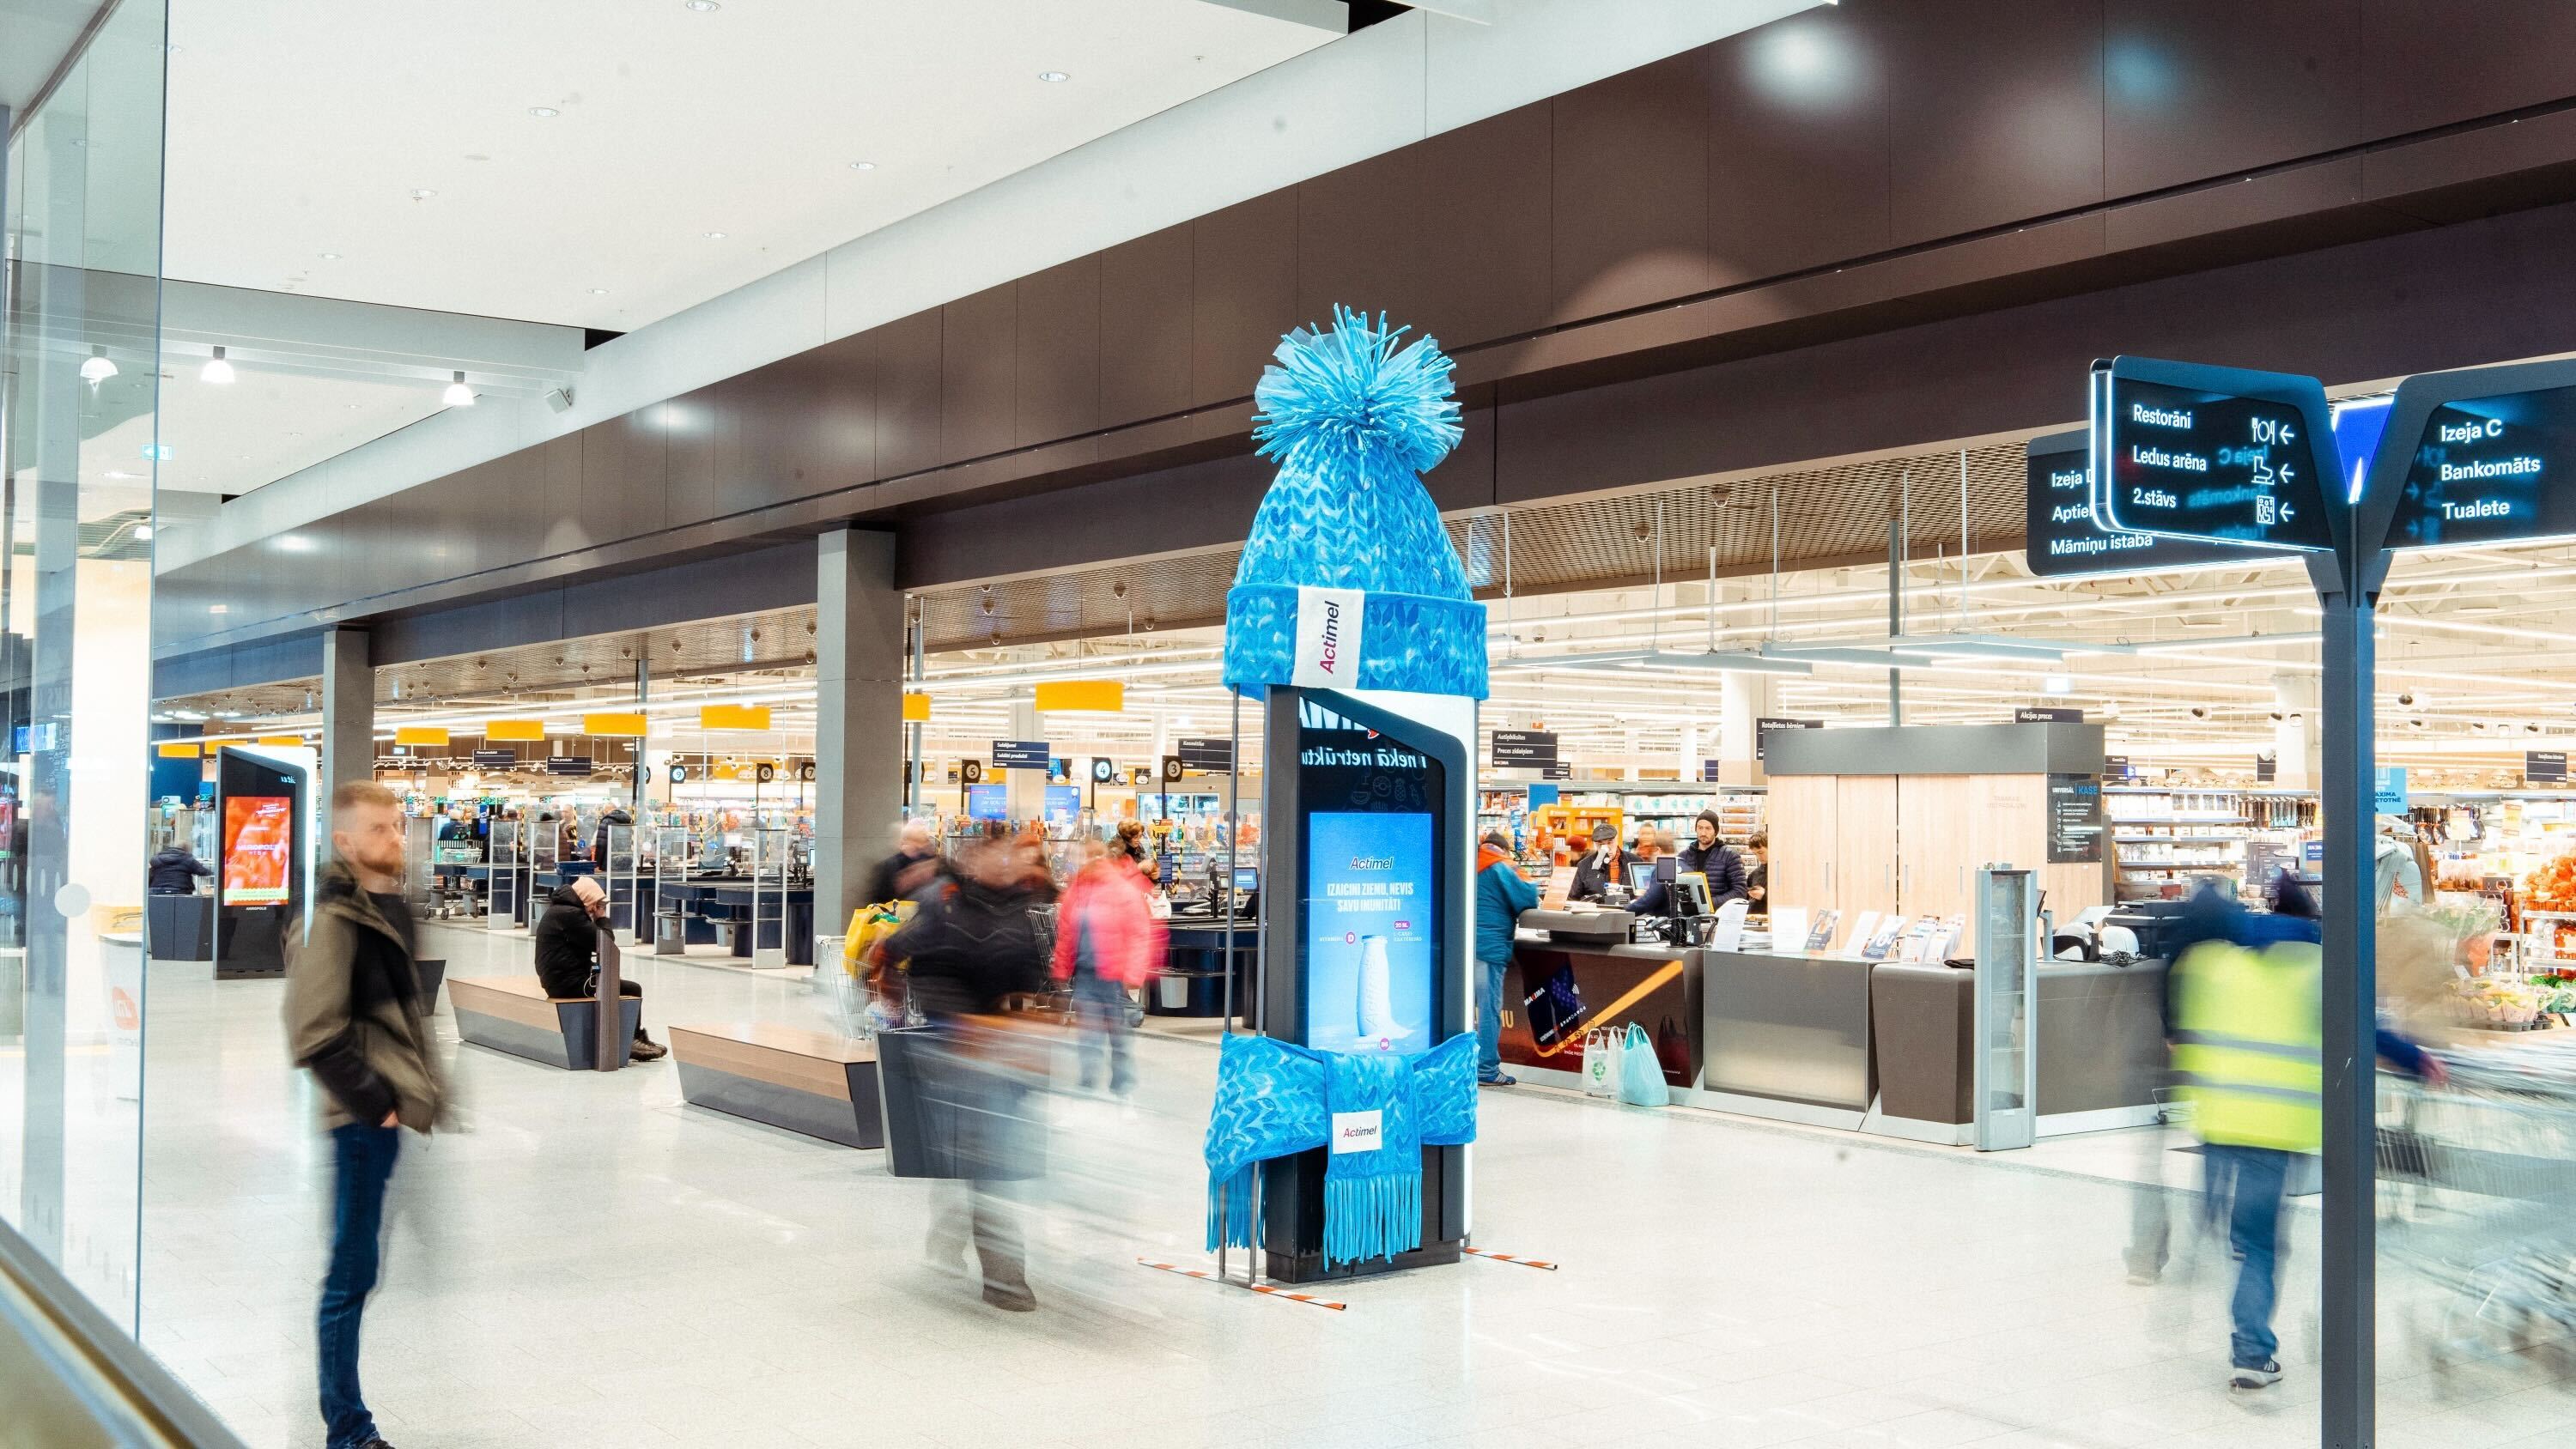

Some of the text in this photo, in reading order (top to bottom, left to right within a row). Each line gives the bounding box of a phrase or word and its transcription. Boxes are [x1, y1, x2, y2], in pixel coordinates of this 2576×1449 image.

[2133, 403, 2191, 429] Restorāni
[2440, 418, 2502, 444] Izeja C
[2133, 445, 2207, 471] Ledus arēna
[2050, 470, 2083, 489] Izeja
[2440, 457, 2542, 482] Bankomāts
[2133, 488, 2177, 509] 2.stāvs
[2051, 503, 2093, 524] Aptie
[2441, 500, 2511, 520] Tualete
[2050, 533, 2154, 555] Māmiņu istaba
[1319, 600, 1340, 675] Actimel
[969, 767, 975, 776] 5
[1099, 765, 1106, 774] 4
[1170, 764, 1177, 774] 3
[1349, 857, 1394, 870] Actimel
[1389, 882, 1414, 896] NEVIS
[1337, 899, 1359, 912] SAVU
[1343, 1125, 1377, 1138] Actimel
